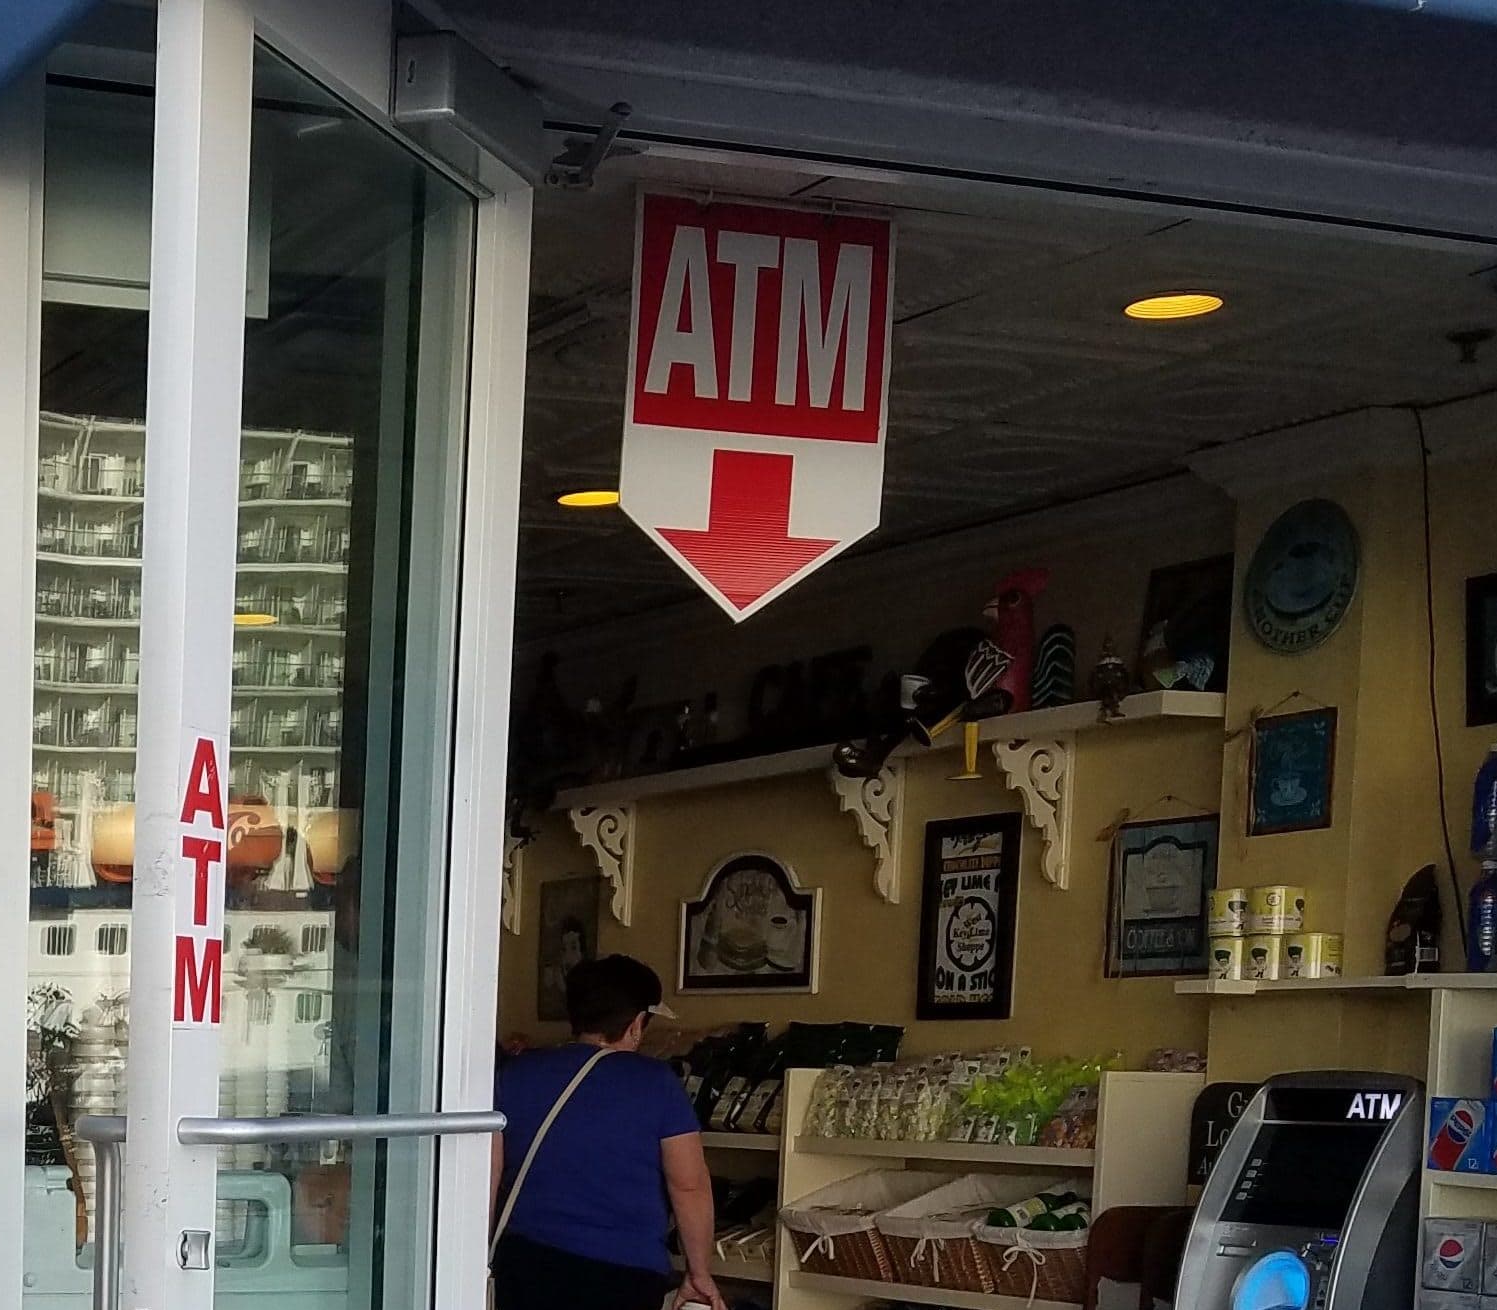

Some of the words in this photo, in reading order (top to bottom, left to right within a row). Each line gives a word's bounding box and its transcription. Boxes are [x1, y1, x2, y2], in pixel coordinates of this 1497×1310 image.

[643, 223, 875, 413] ATM
[174, 737, 225, 1024] ATM
[970, 968, 996, 990] STIC
[1345, 1091, 1403, 1121] ATM
